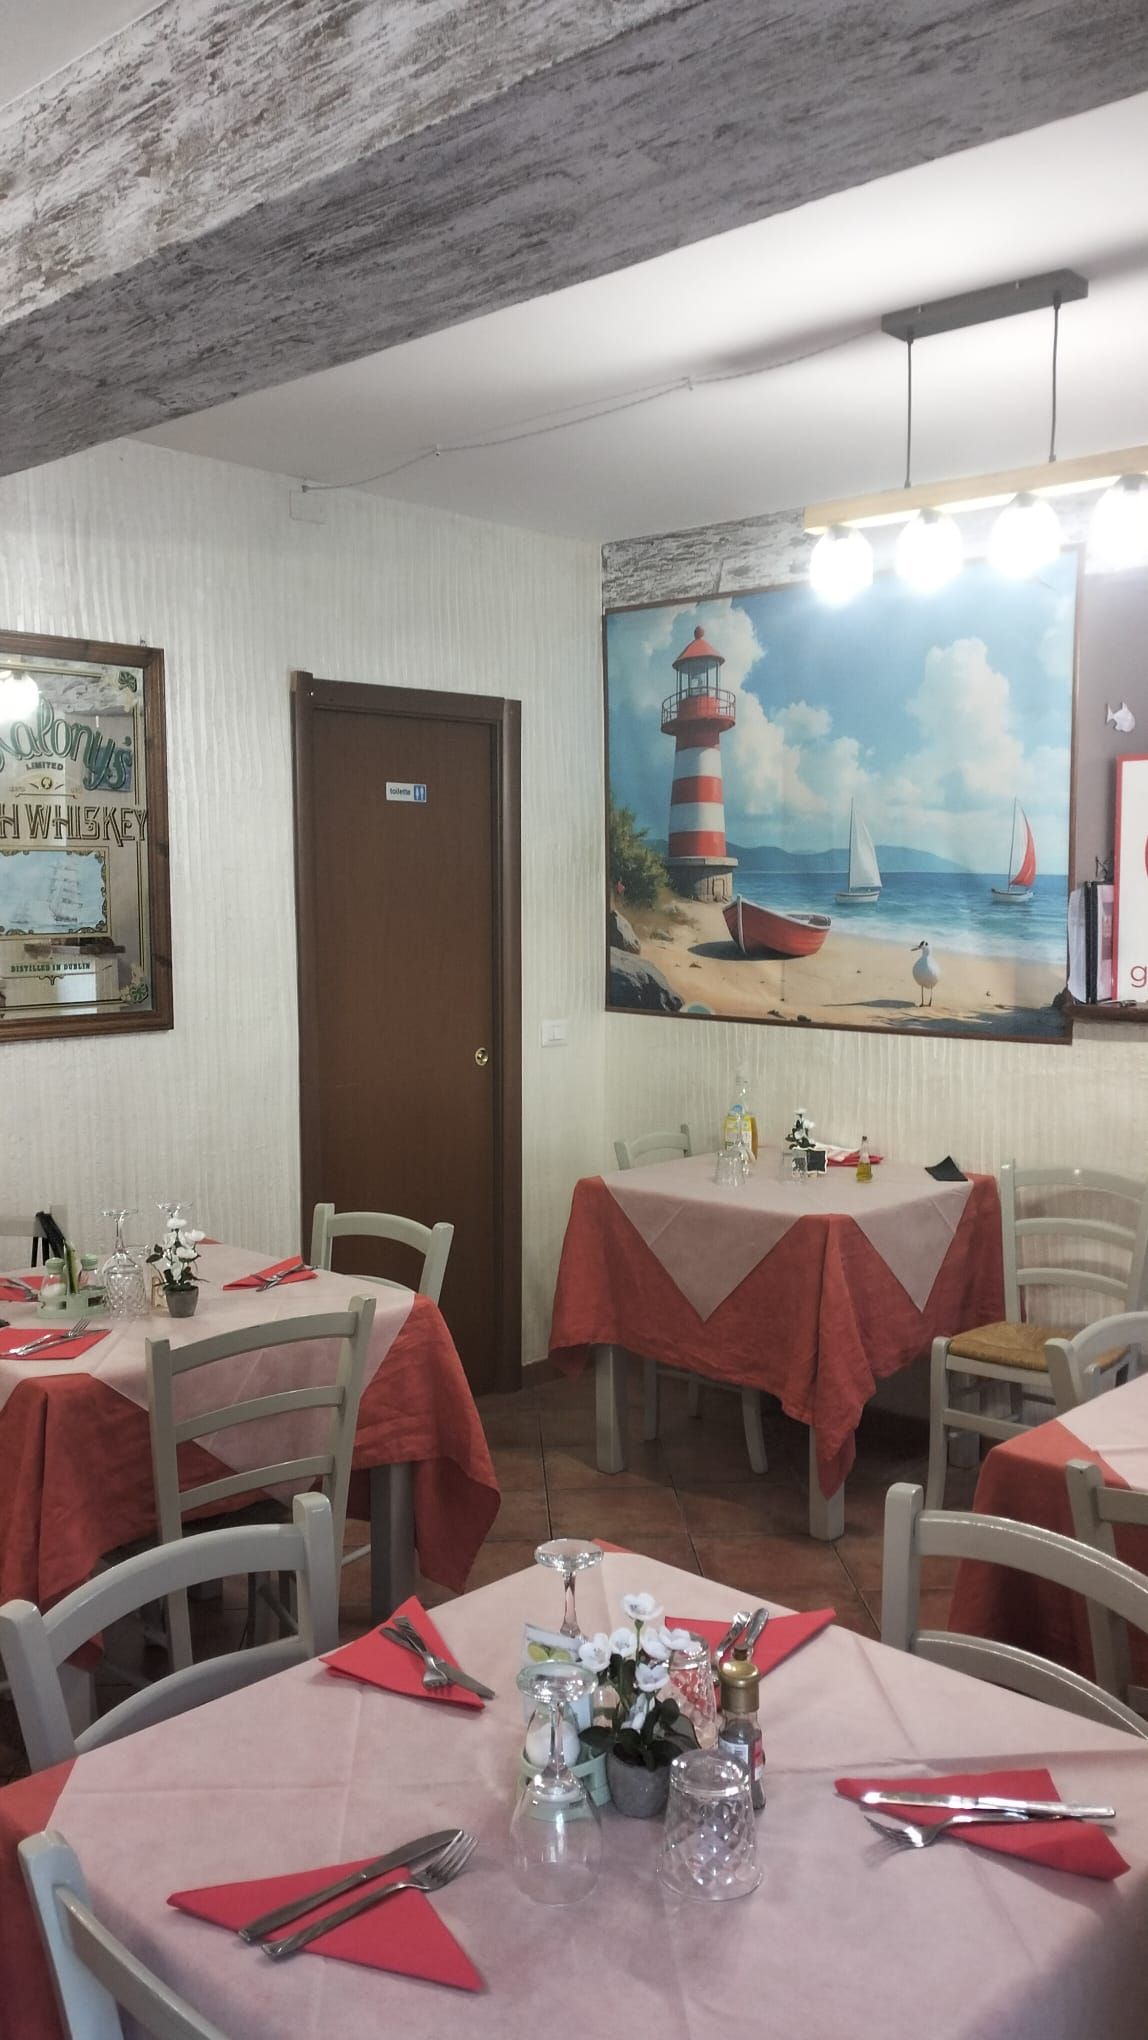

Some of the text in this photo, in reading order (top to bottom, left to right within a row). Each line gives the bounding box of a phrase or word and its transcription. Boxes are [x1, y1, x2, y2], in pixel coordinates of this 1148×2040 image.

[26, 761, 64, 771] LIMITED
[25, 804, 148, 847] WHISKEY
[10, 962, 91, 973] DISTILLED IN DUBLIN
